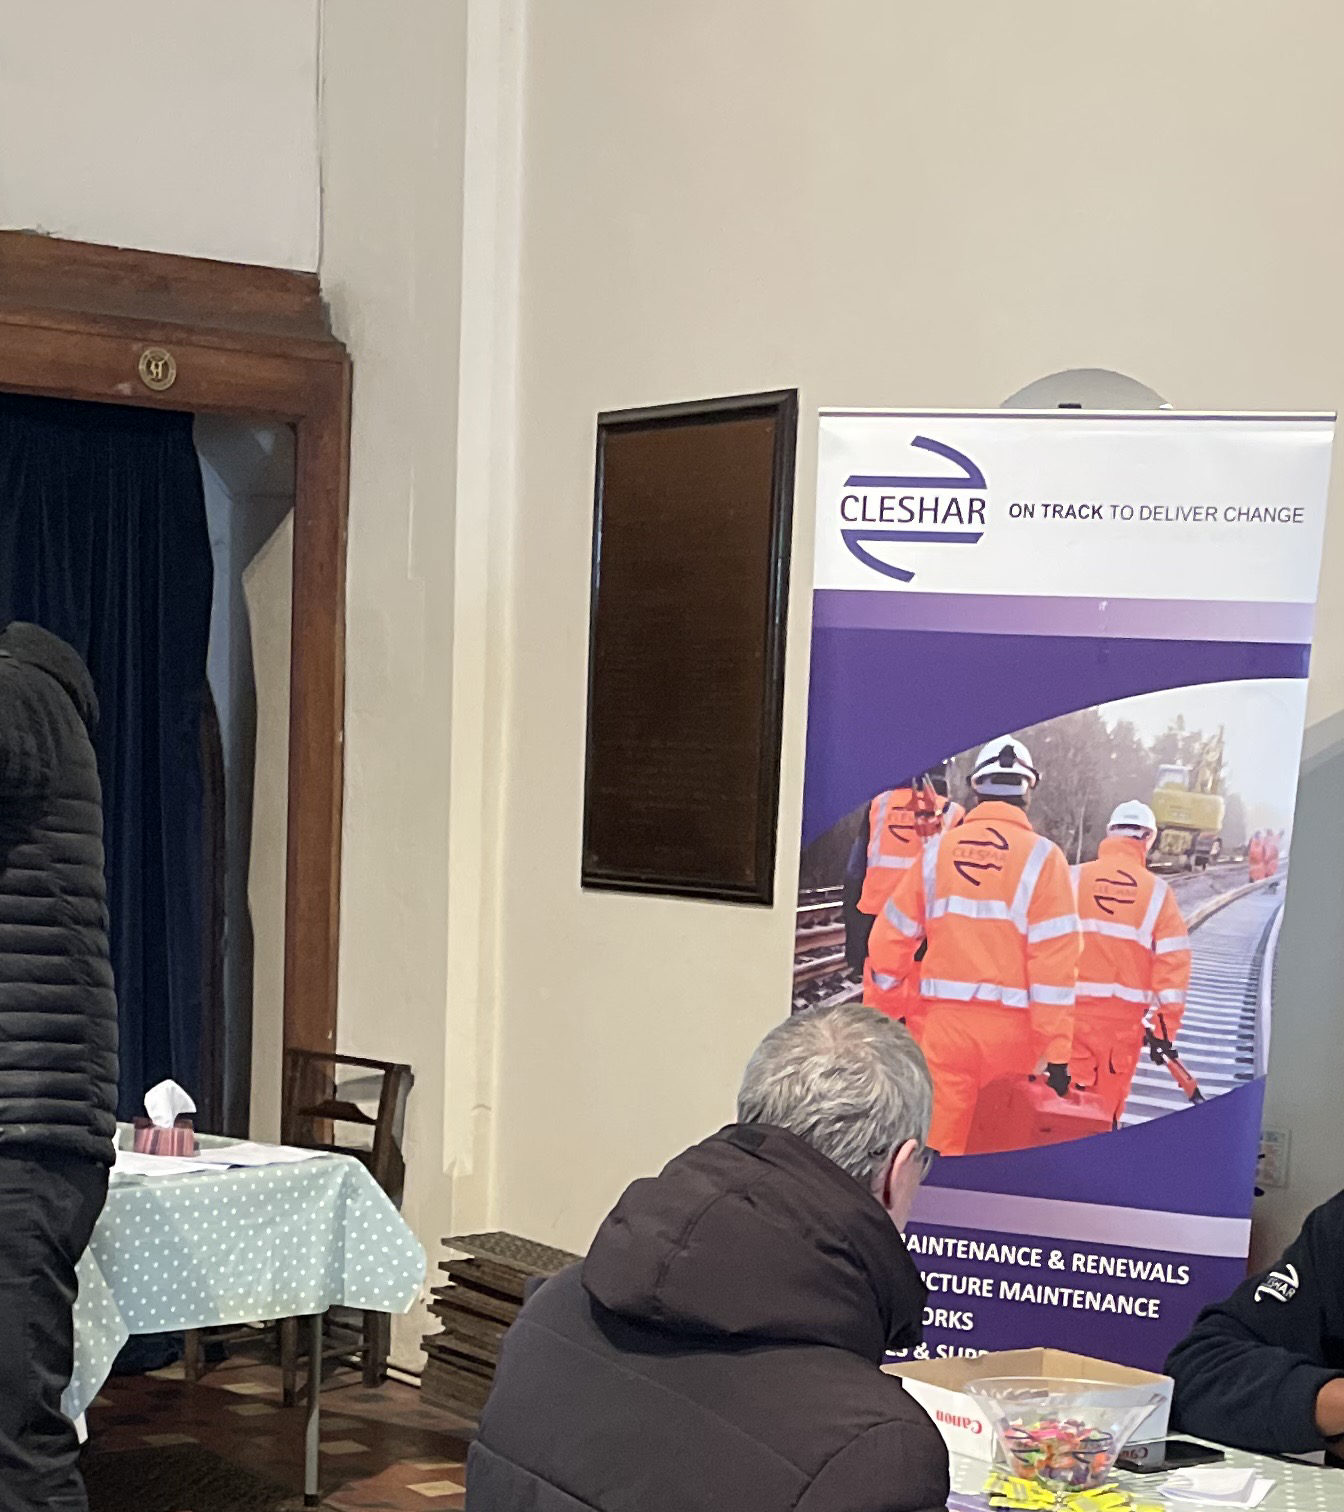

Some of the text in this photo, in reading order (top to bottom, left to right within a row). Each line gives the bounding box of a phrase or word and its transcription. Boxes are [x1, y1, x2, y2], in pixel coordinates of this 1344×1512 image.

[840, 495, 986, 525] CLESHAR
[1009, 503, 1305, 524] ON TRACK TO DELIVER CHANGE
[1047, 1249, 1066, 1271] &
[1072, 1252, 1191, 1286] RENEWALS
[999, 1279, 1161, 1319] MAINTENANCE
[913, 1342, 930, 1360] &
[936, 1344, 989, 1359] SUP
[935, 1408, 984, 1435] Canon
